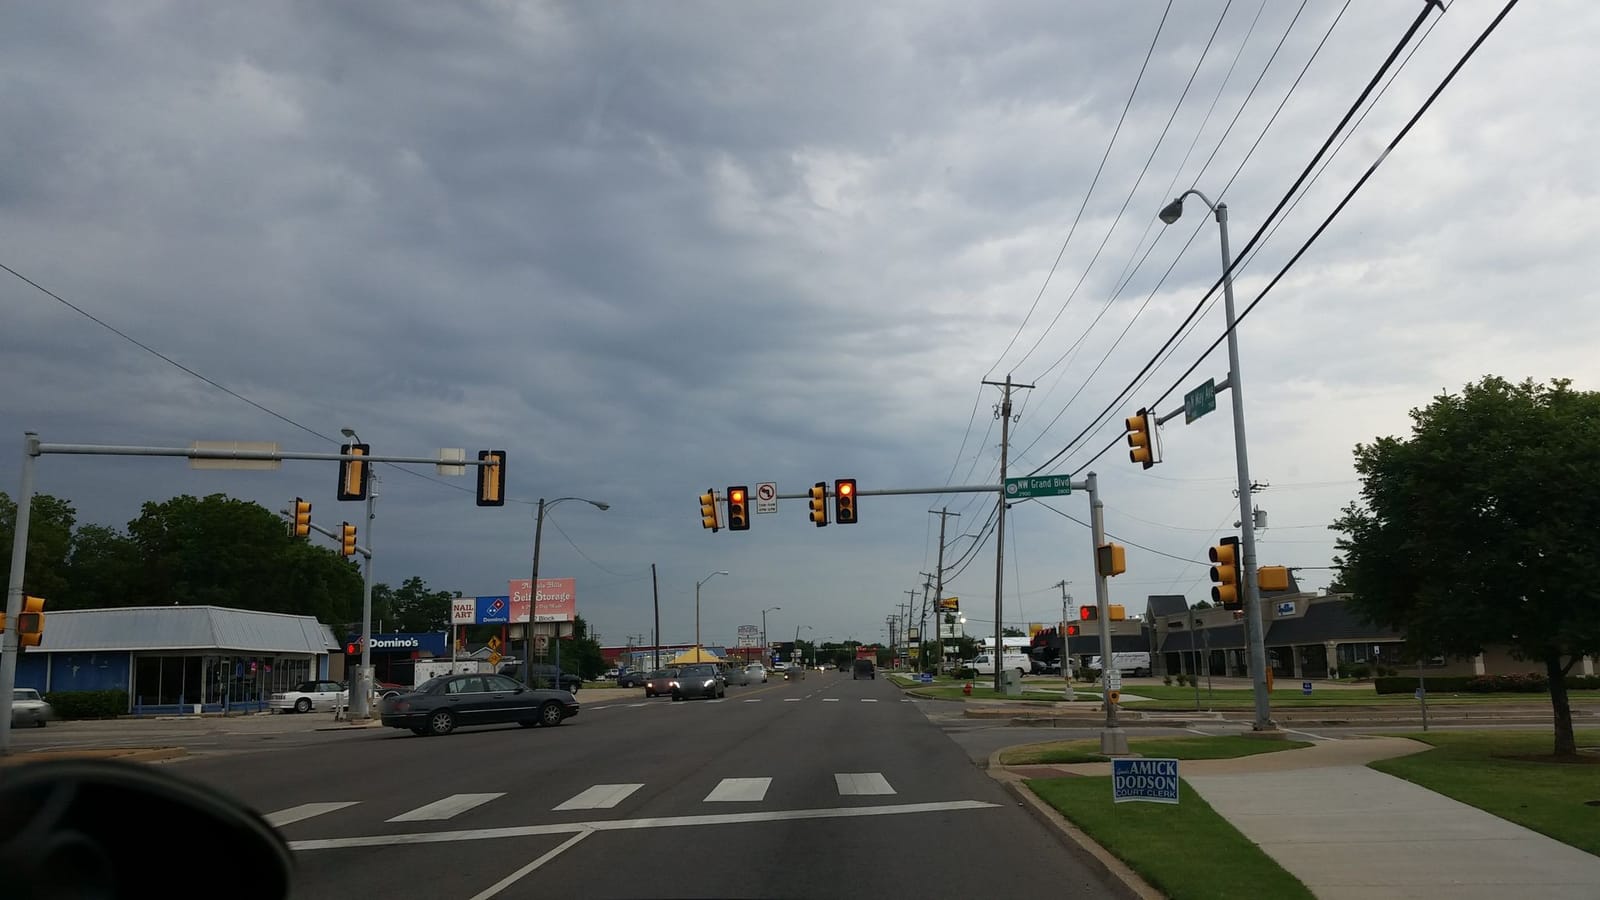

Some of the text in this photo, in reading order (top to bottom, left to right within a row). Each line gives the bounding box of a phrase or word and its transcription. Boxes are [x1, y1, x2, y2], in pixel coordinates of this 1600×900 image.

[1017, 478, 1070, 489] NW Grand Blvd
[535, 590, 571, 602] Storage
[453, 604, 474, 612] NAIL
[454, 611, 473, 619] ART
[369, 636, 419, 648] Domino's
[1129, 761, 1176, 775] AMICK
[1116, 775, 1176, 790] DODSON
[1116, 789, 1176, 798] COURT CLERK
